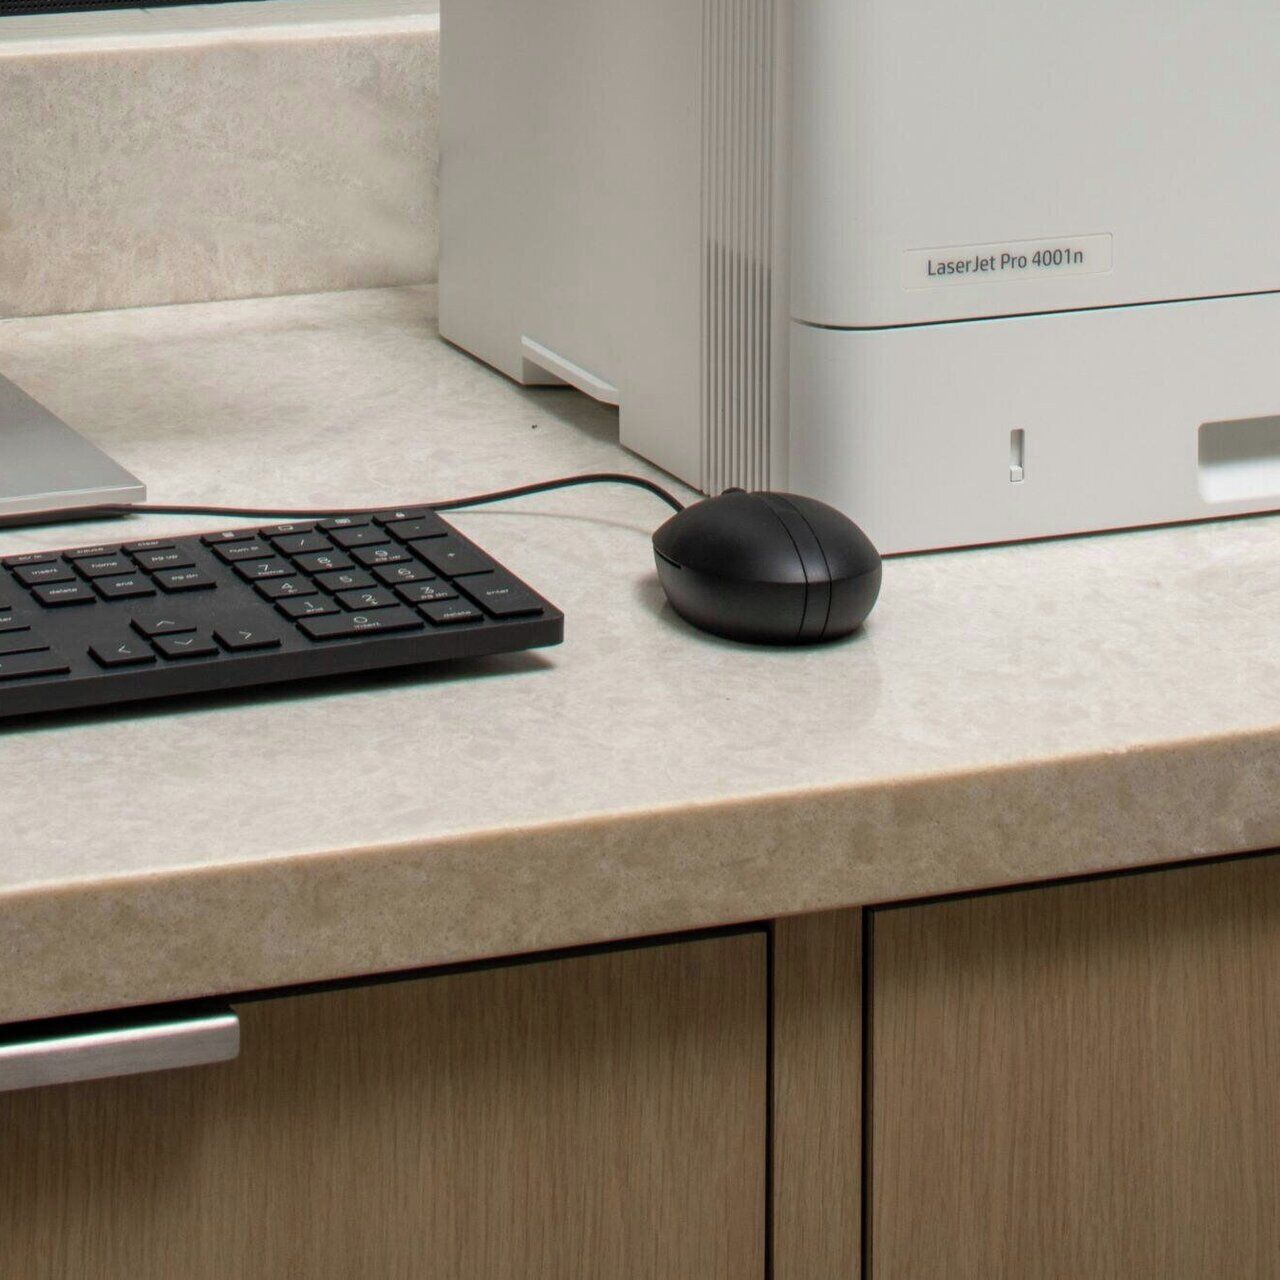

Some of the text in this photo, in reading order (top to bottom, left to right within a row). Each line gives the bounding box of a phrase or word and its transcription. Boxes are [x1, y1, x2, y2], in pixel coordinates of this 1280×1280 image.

[927, 248, 1084, 276] LaserJet Pro 4001n
